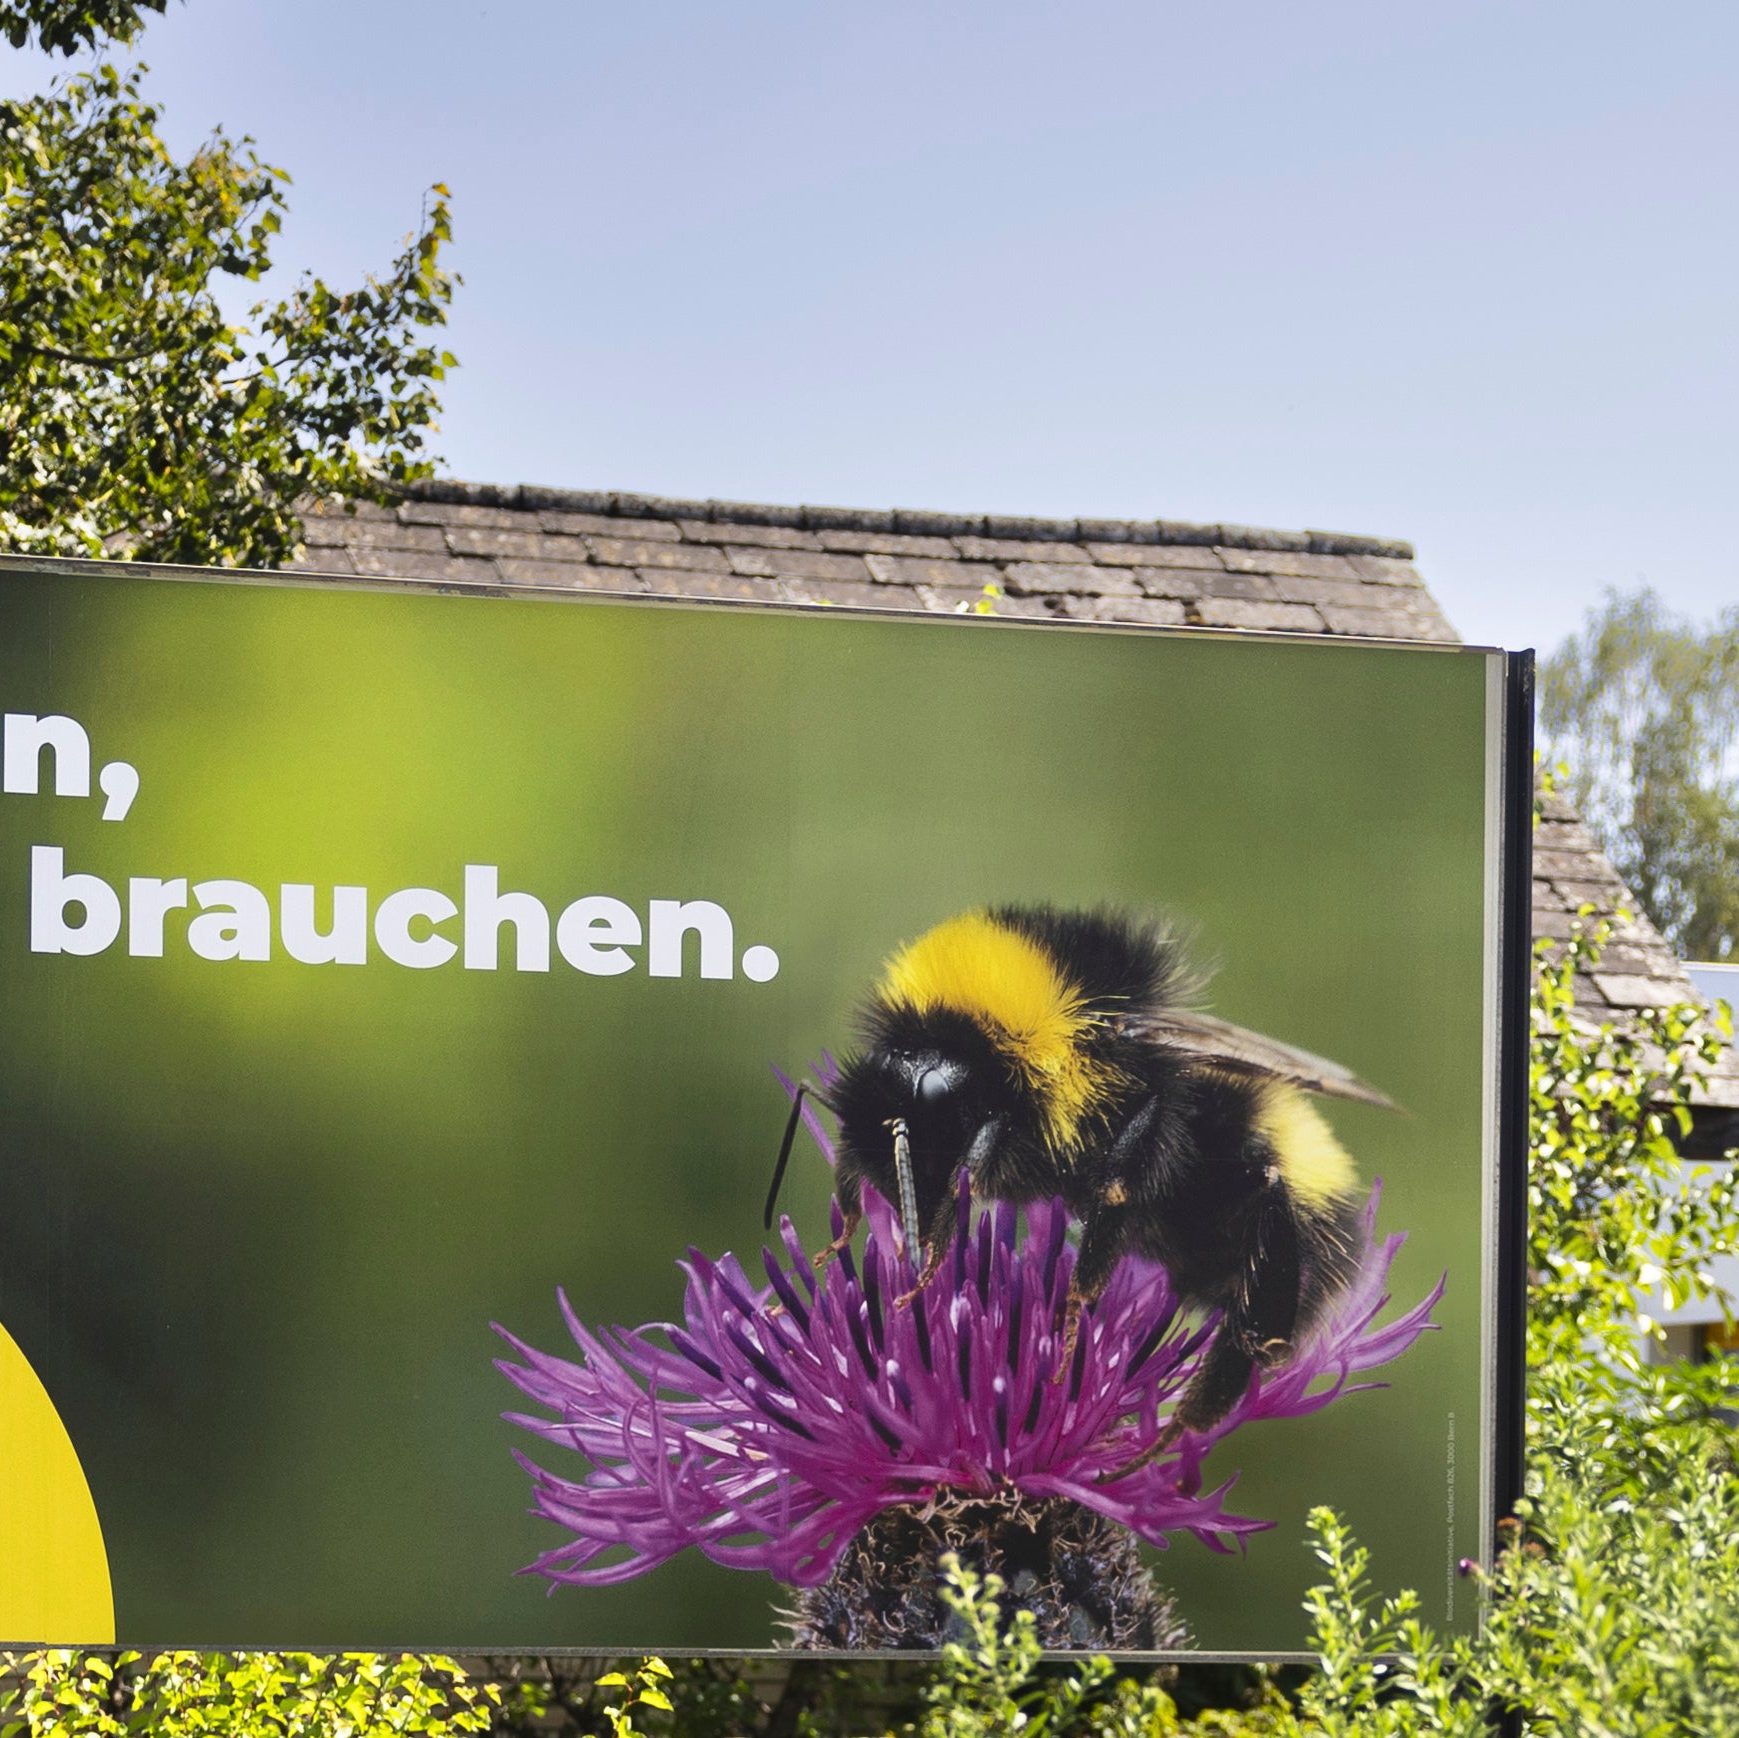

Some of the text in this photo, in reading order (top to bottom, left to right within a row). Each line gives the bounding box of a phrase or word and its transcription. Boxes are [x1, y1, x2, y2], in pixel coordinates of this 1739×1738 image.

[30, 845, 780, 983] brauchen.
[1447, 1419, 1455, 1441] Bern
[1447, 1442, 1455, 1464] 3000
[1446, 1485, 1455, 1523] Postfach
